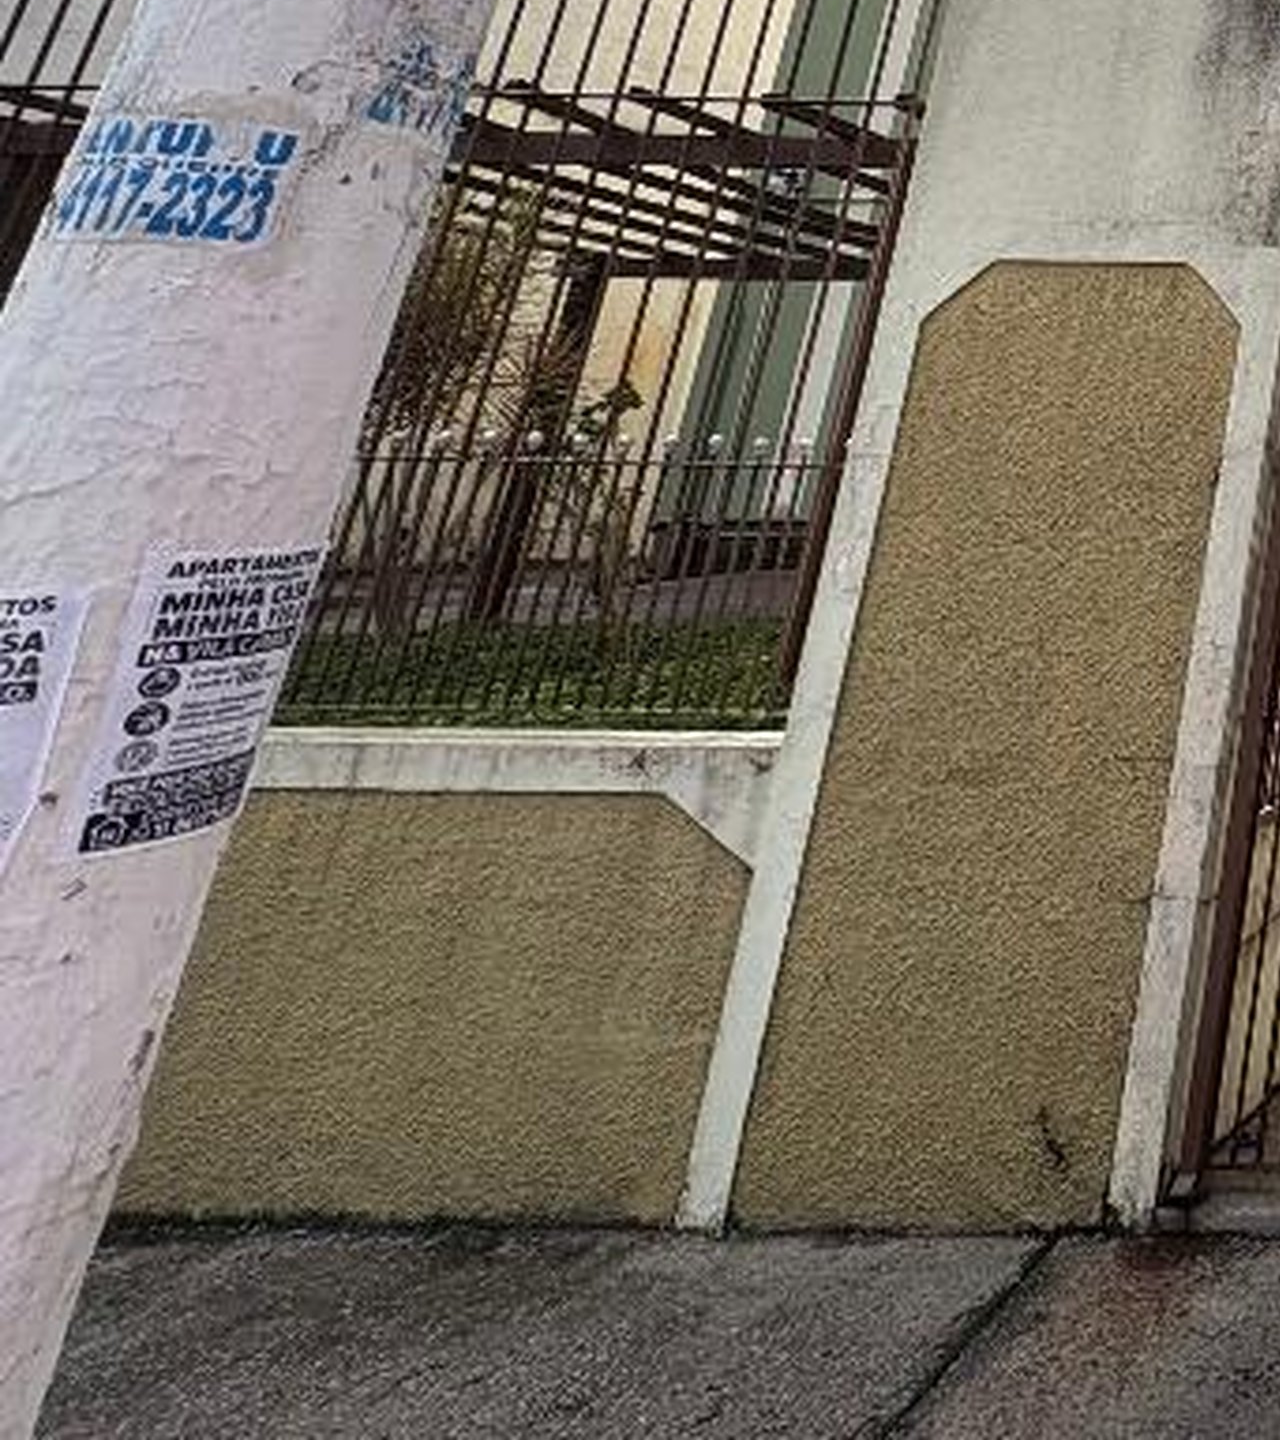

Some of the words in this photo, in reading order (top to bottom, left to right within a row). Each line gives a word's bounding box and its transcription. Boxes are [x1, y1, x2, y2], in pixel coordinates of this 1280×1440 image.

[159, 587, 265, 615] MINHA
[152, 608, 260, 640] MINHA
[0, 630, 44, 653] SA
